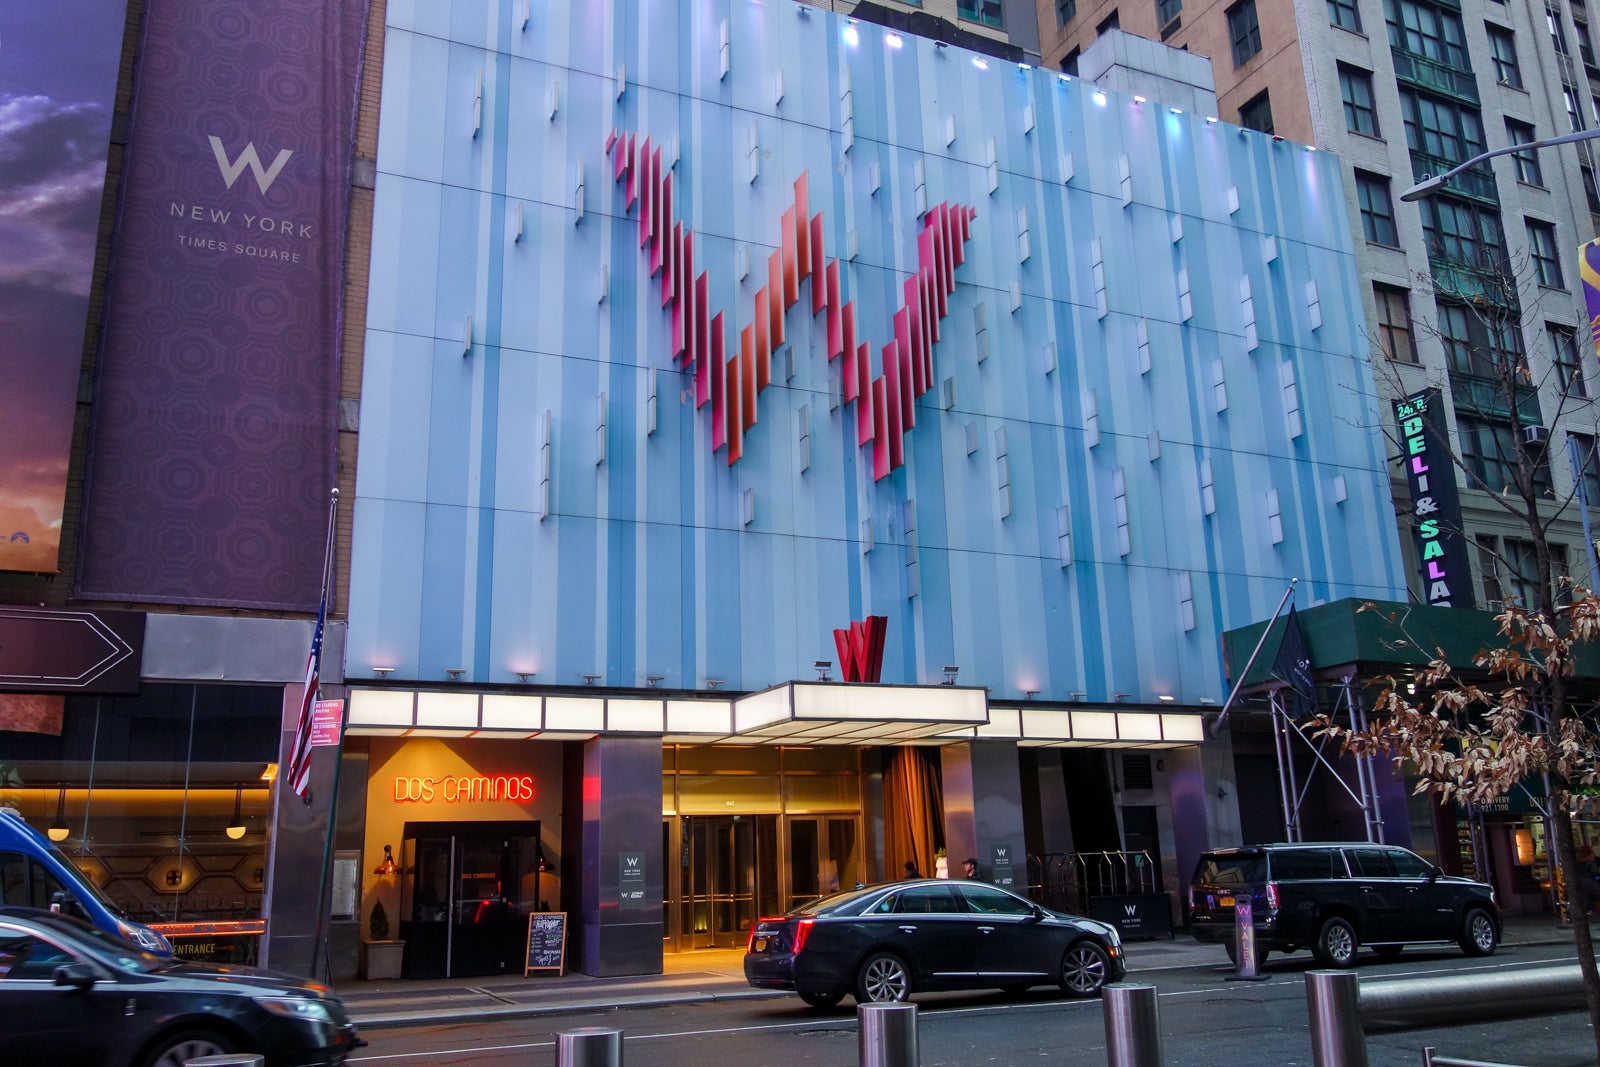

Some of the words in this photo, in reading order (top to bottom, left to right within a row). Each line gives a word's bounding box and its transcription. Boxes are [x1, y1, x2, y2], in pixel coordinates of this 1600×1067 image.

[207, 135, 295, 196] W
[170, 202, 231, 225] NEW
[243, 213, 312, 239] YORK
[178, 235, 228, 252] TIMES
[235, 244, 301, 264] SQUARE
[1403, 416, 1430, 493] DELI
[1416, 497, 1440, 516] &
[1419, 519, 1452, 608] SALA
[833, 615, 888, 683] W
[394, 776, 435, 801] DOS
[443, 776, 533, 801] CAMINOS
[626, 857, 638, 867] W
[996, 848, 1006, 857] W
[1124, 904, 1136, 916] W
[1236, 905, 1251, 916] W
[173, 943, 216, 955] ENTRANCE
[1240, 921, 1249, 969] VALET
